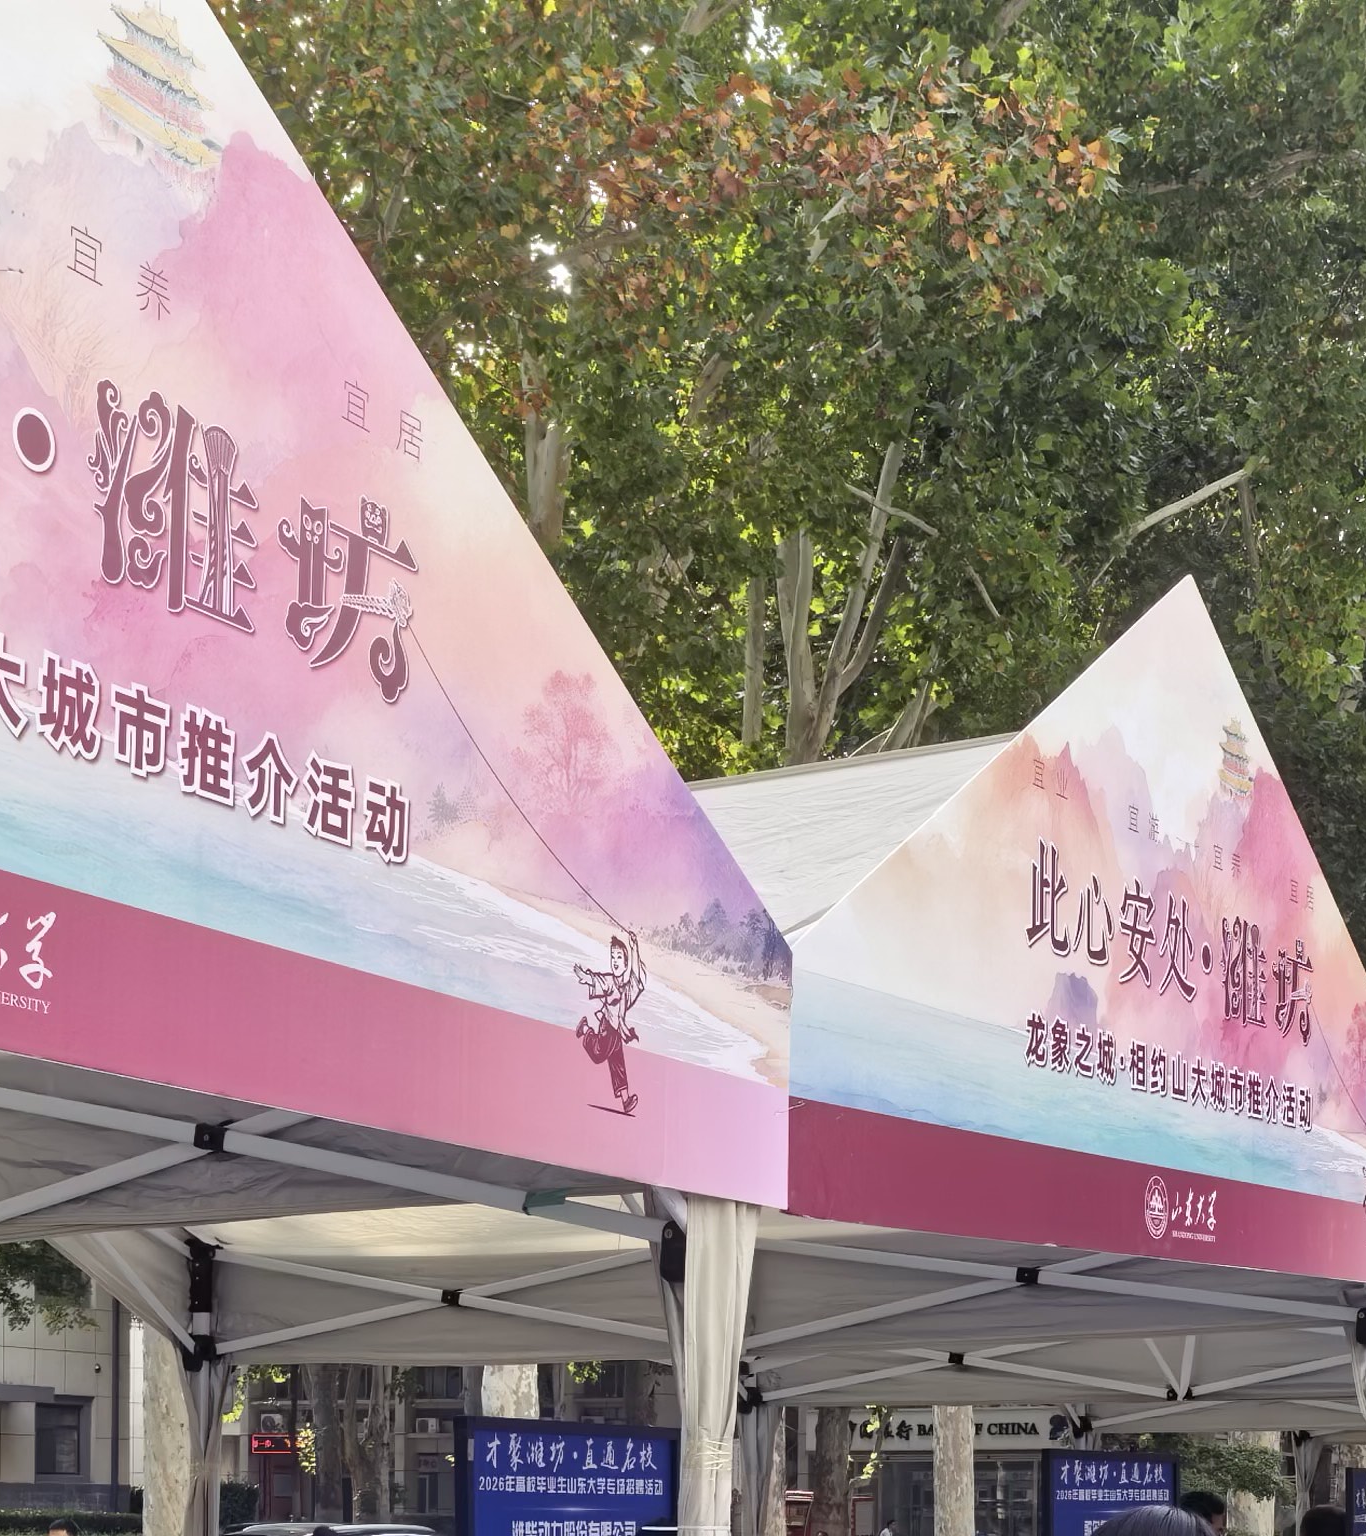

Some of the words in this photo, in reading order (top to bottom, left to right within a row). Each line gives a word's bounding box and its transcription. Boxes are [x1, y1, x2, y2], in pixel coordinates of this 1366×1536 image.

[68, 224, 172, 321] 宜养
[340, 377, 426, 459] 宜居
[986, 1422, 1040, 1436] CHINA
[486, 1432, 658, 1474] 才聚潍坊·直通名校
[478, 1474, 664, 1497] 2026年高校毕业生山东大学专场招聘活动
